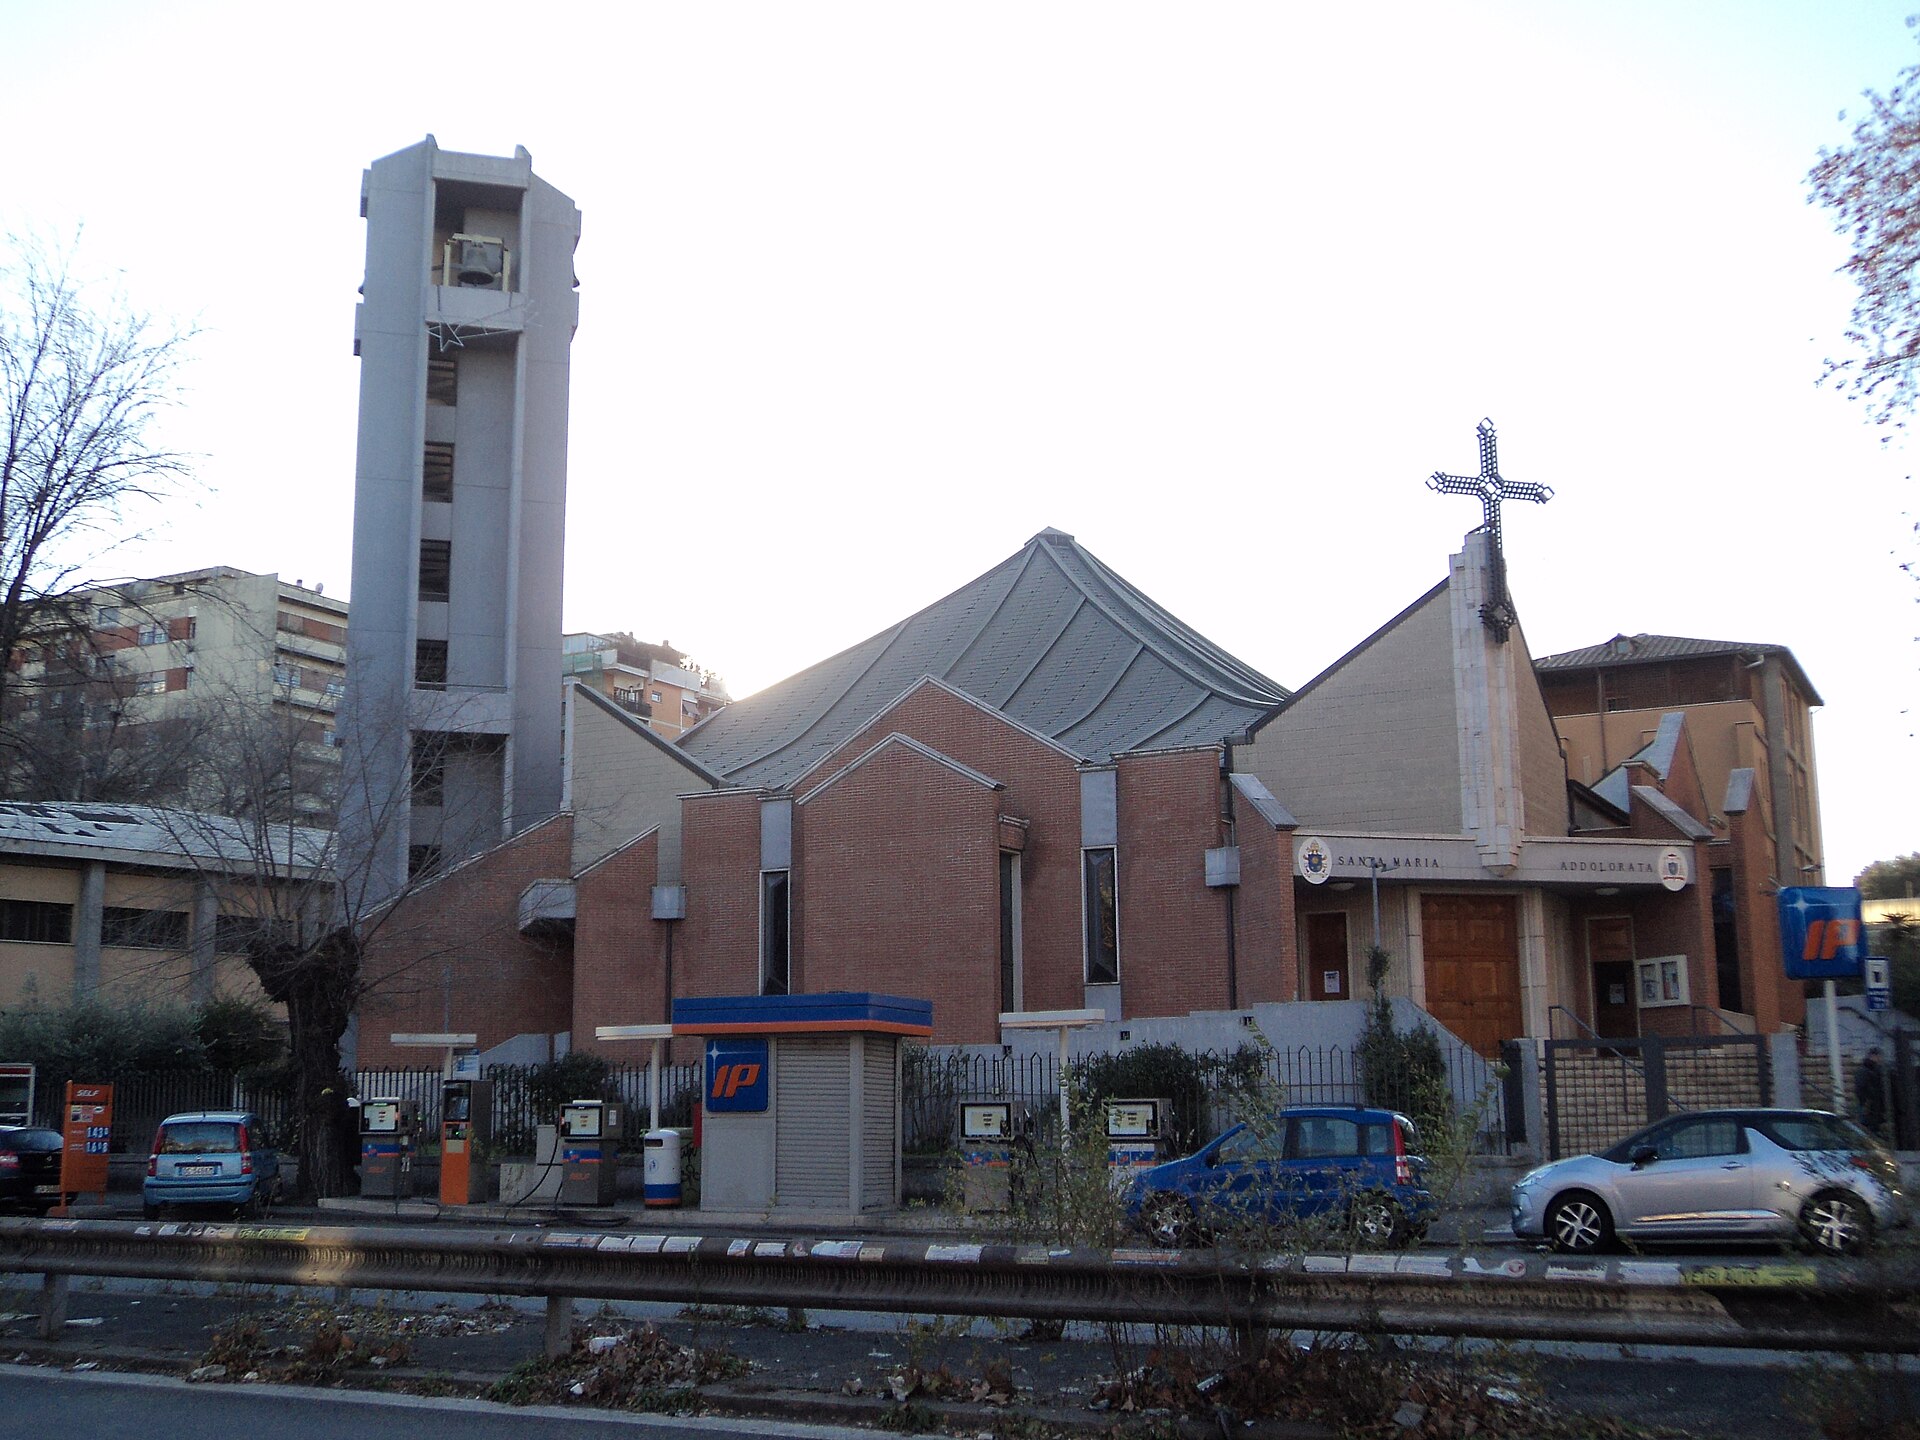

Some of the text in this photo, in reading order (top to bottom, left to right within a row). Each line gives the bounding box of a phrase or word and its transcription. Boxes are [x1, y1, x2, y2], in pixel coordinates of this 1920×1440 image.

[1338, 856, 1439, 868] SANTA MARIA
[1560, 861, 1653, 873] ADDOLORATA
[1803, 919, 1860, 960] IP
[711, 1064, 760, 1098] IP
